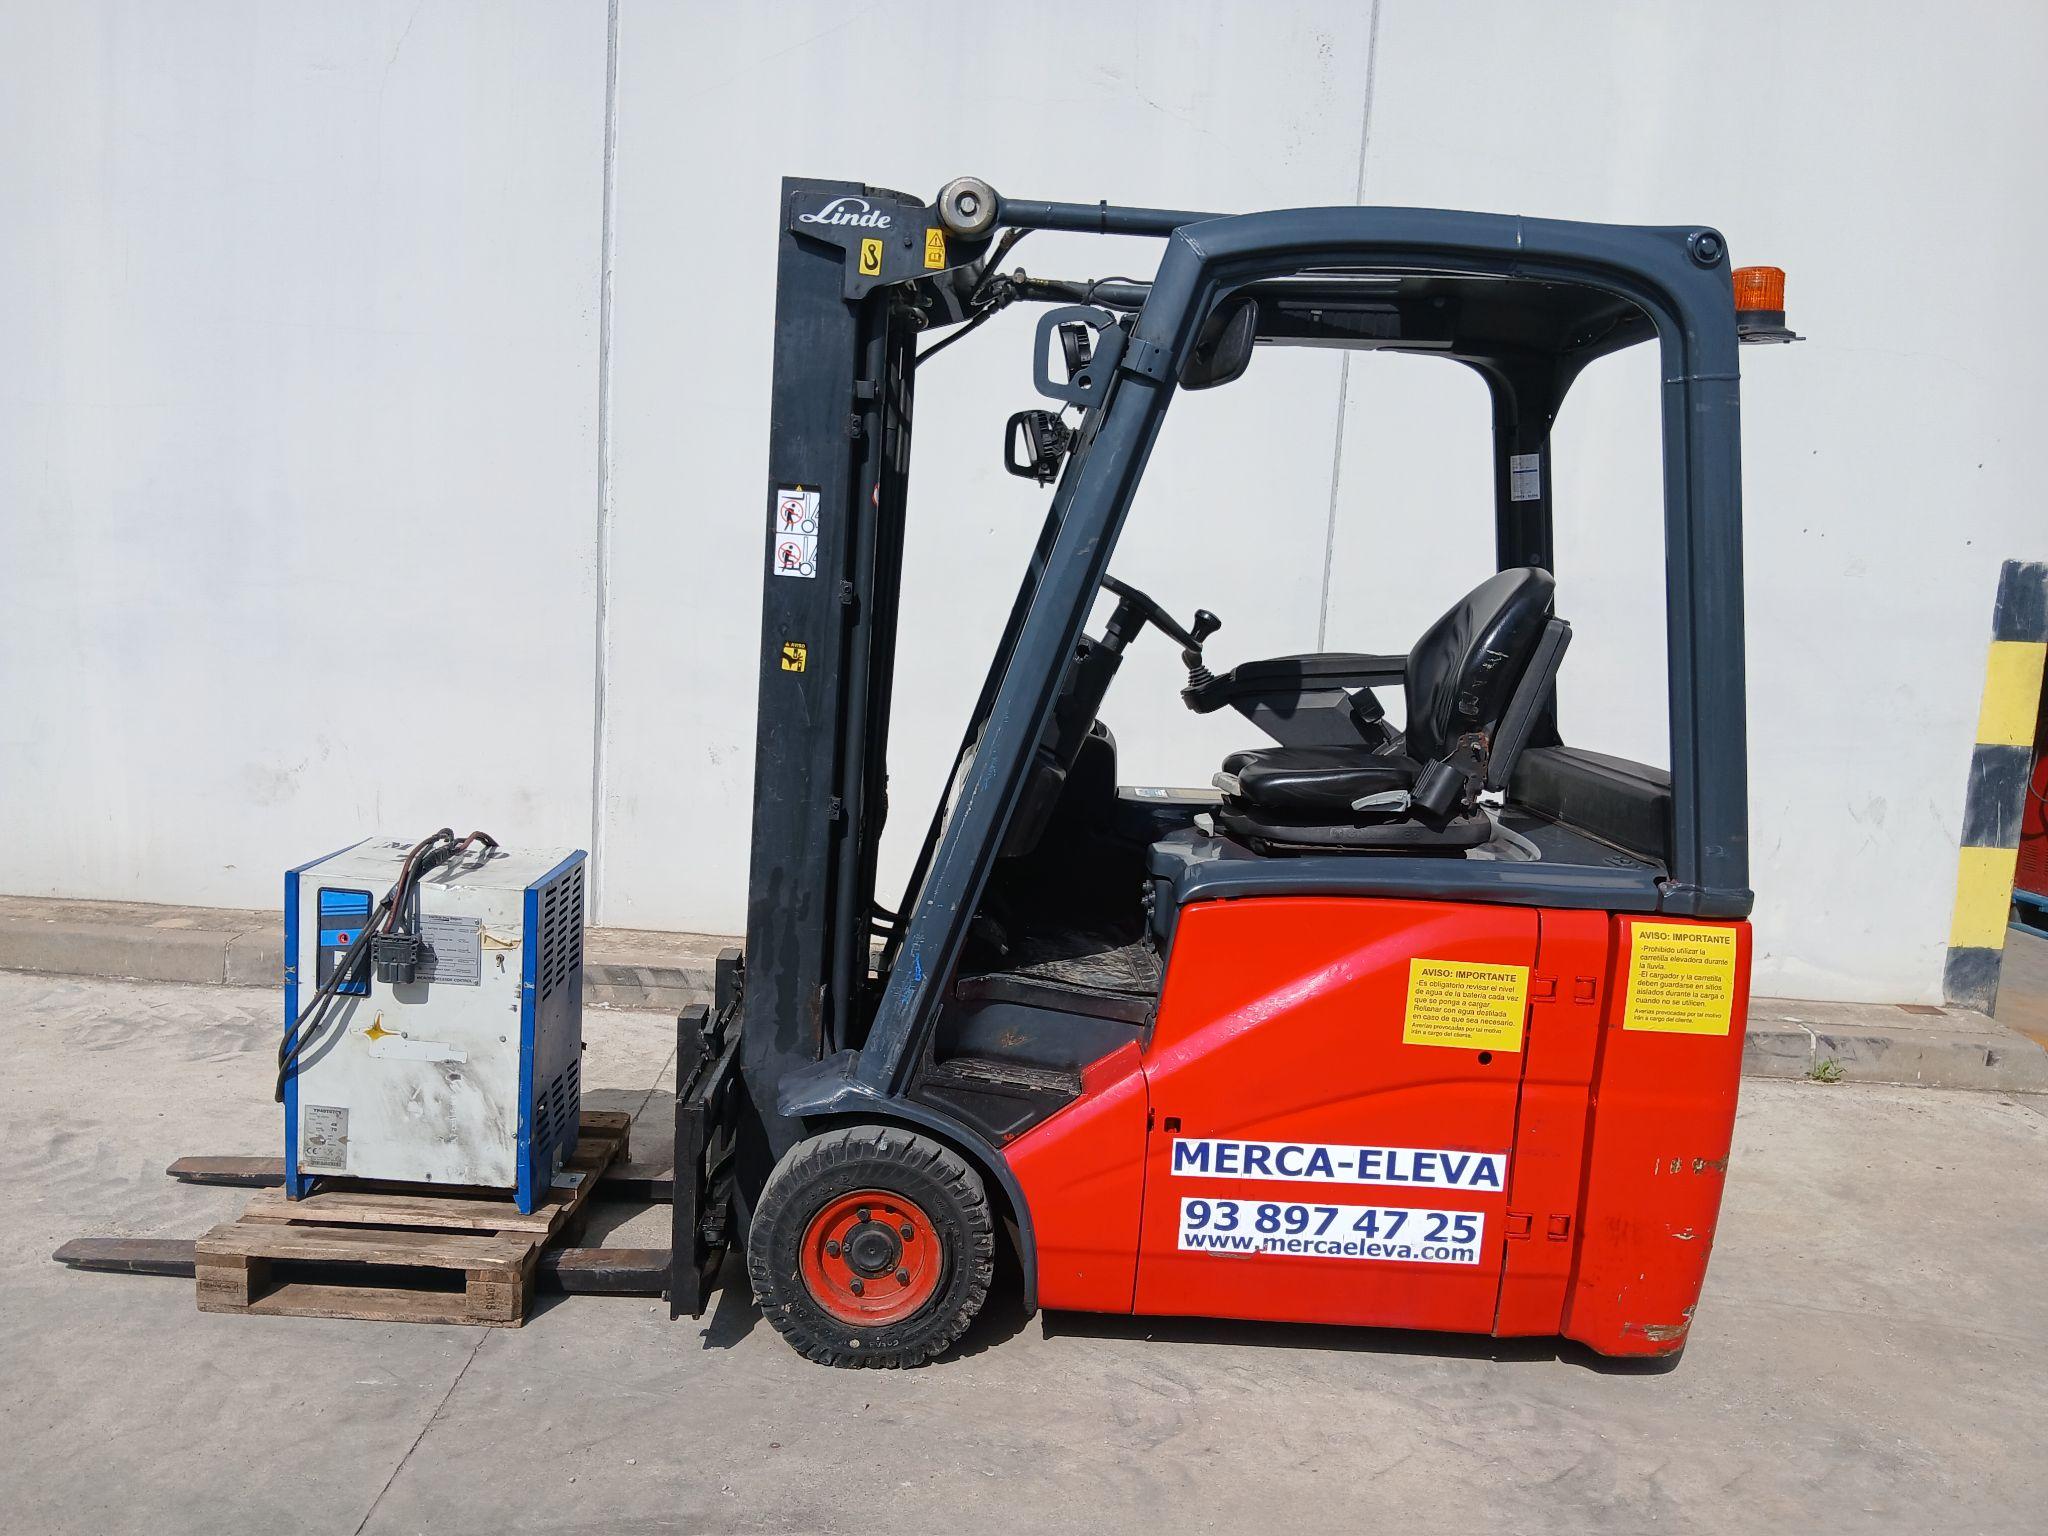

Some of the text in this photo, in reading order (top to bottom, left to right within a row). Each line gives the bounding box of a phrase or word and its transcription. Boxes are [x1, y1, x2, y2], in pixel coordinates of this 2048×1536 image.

[799, 197, 892, 229] Linde
[1639, 931, 1730, 944] AVISO: IMPORTANTE
[1670, 956, 1702, 964] elevadora
[1422, 969, 1516, 982] AVISO: IMPORTANTE
[1649, 972, 1679, 980] cargador
[1430, 981, 1464, 989] obligatorio
[1477, 1009, 1506, 1017] destilada
[1656, 1009, 1686, 1017] provocadas
[1480, 1018, 1515, 1026] necesario.
[1173, 1140, 1500, 1188] MERCA-ELEVA
[1184, 1200, 1478, 1245] 93 897 47 25
[1184, 1232, 1474, 1263] www.mercaeleva.com
